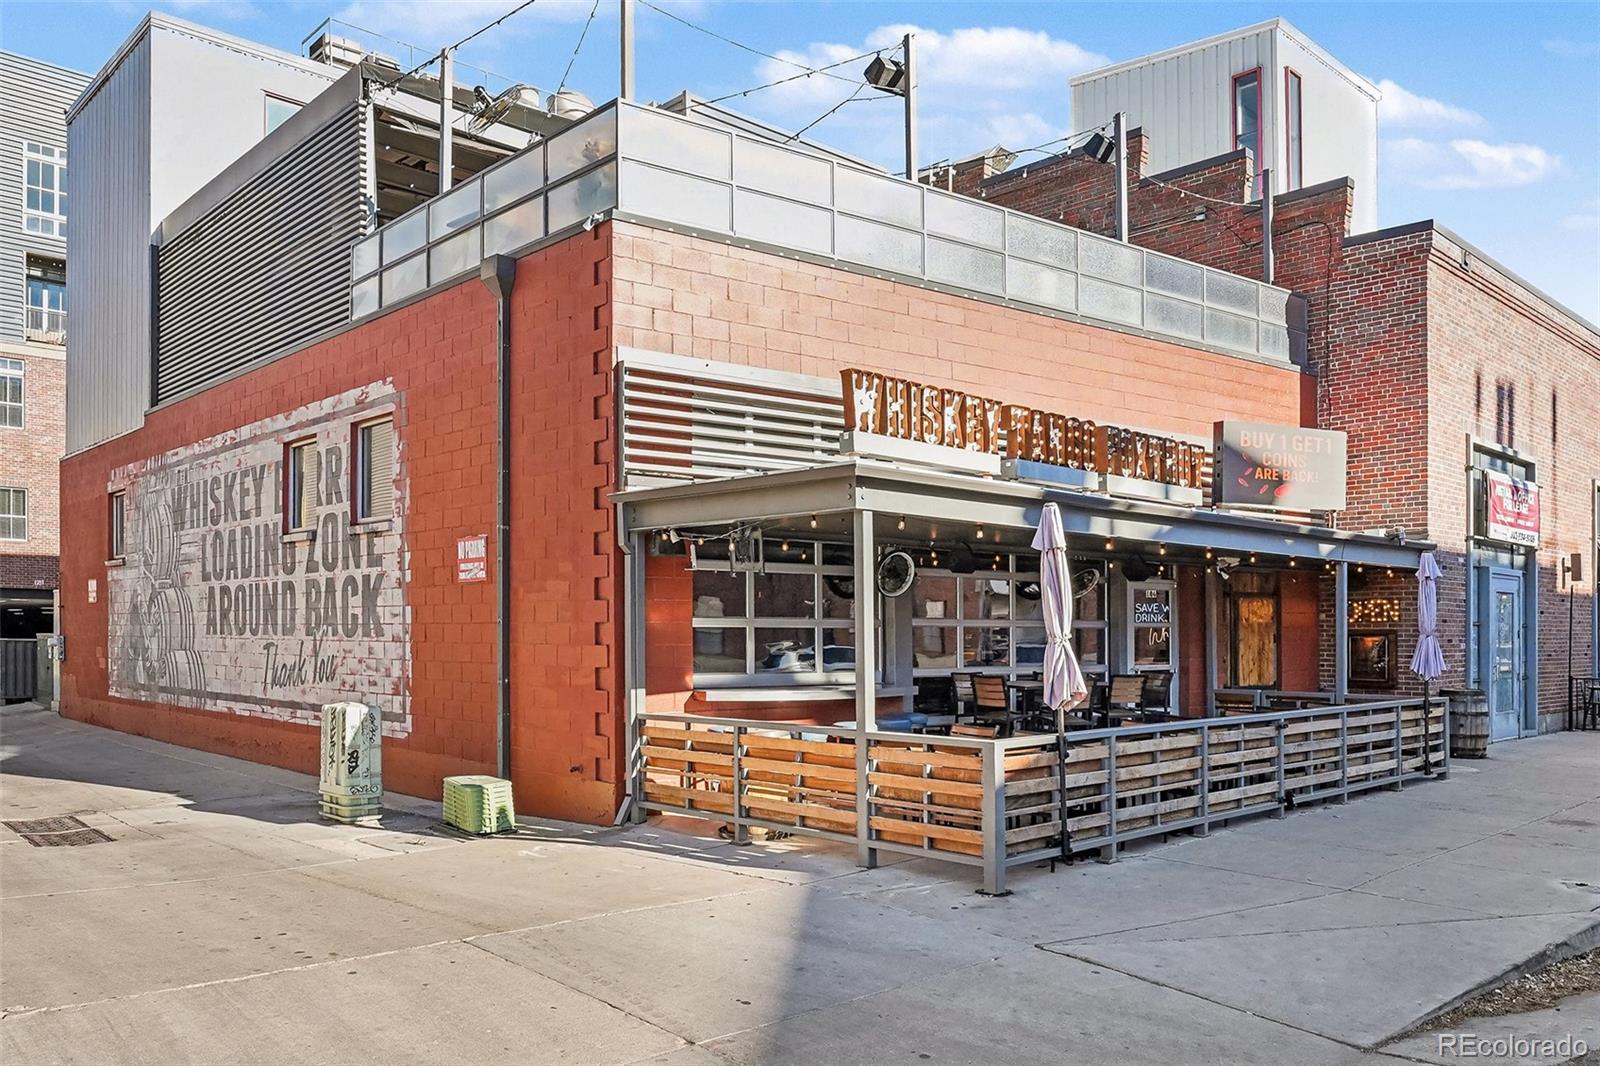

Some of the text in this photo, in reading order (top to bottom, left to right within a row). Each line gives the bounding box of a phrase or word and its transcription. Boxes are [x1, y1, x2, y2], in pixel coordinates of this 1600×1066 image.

[841, 367, 1206, 490] WHISKEY TANGO FOXTROT
[1240, 430, 1276, 450] BUY
[1280, 433, 1287, 450] 1
[1262, 451, 1307, 468] COINS
[1254, 467, 1319, 483] ARE BACK!
[171, 463, 267, 532] WHISKEY
[206, 573, 385, 639] AROUND BACK
[1135, 602, 1170, 613] SAVE W
[1135, 613, 1165, 623] DRINK
[263, 627, 341, 696] Thank You
